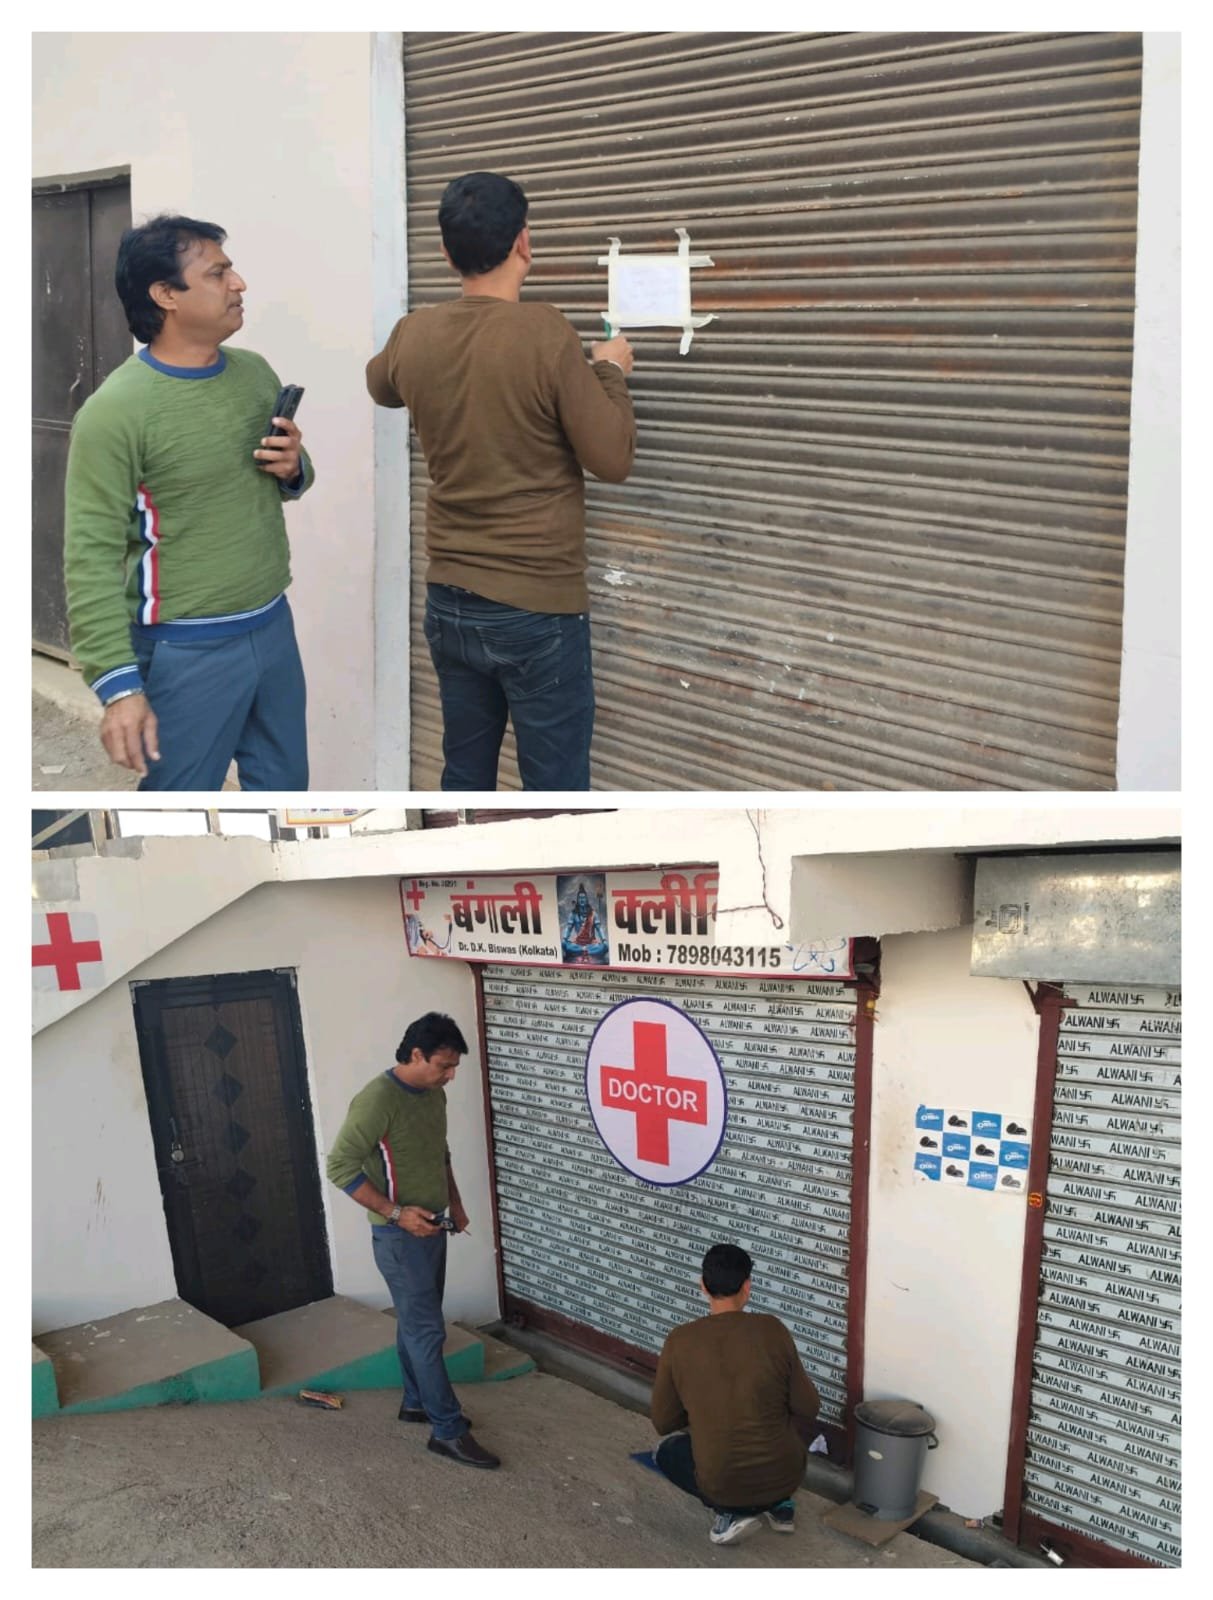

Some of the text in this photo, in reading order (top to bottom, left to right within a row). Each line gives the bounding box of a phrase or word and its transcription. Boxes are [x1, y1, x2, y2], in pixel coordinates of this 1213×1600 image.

[450, 881, 542, 934] बंगाली
[459, 942, 469, 951] Dr.
[488, 945, 516, 954] Biswas
[519, 944, 557, 959] (Kolkata)
[618, 943, 652, 962] Mob
[667, 945, 781, 967] 7898043115
[1088, 992, 1128, 1004] ALWANI
[1065, 1015, 1104, 1028] ALWANI
[1110, 1043, 1151, 1057] ALWANI
[1097, 1067, 1136, 1081] ALWANI
[609, 1078, 698, 1112] DOCTOR
[1111, 1093, 1152, 1107] ALWANI
[1107, 1118, 1147, 1130] ALWANI
[1109, 1142, 1149, 1158] ALWANI
[1123, 1169, 1164, 1184] ALWANI
[1063, 1184, 1176, 1211] ALWANI ALWANI
[1095, 1212, 1133, 1228] ALWANI
[1056, 1228, 1166, 1259] ALWANI ALWANI
[1078, 1254, 1116, 1271] ALWANI
[1105, 1283, 1144, 1300] ALWANI
[1050, 1293, 1157, 1326] ALWANI ALWANI
[1069, 1319, 1179, 1355] ALWANI ALWANI
[1058, 1338, 1165, 1374] ALWANI ALWANI
[1058, 1359, 1165, 1396] ALWANI ALWANI
[1100, 1393, 1137, 1411] ALWANI
[1050, 1399, 1154, 1439] ALWANI ALWANI
[1058, 1422, 1163, 1463] ALWANI ALWANI
[1087, 1453, 1123, 1472] ALWANI
[1090, 1474, 1127, 1494] ALWANI
[1055, 1482, 1157, 1526] ALWANI ALWANI
[1089, 1515, 1125, 1535] ALWANI
